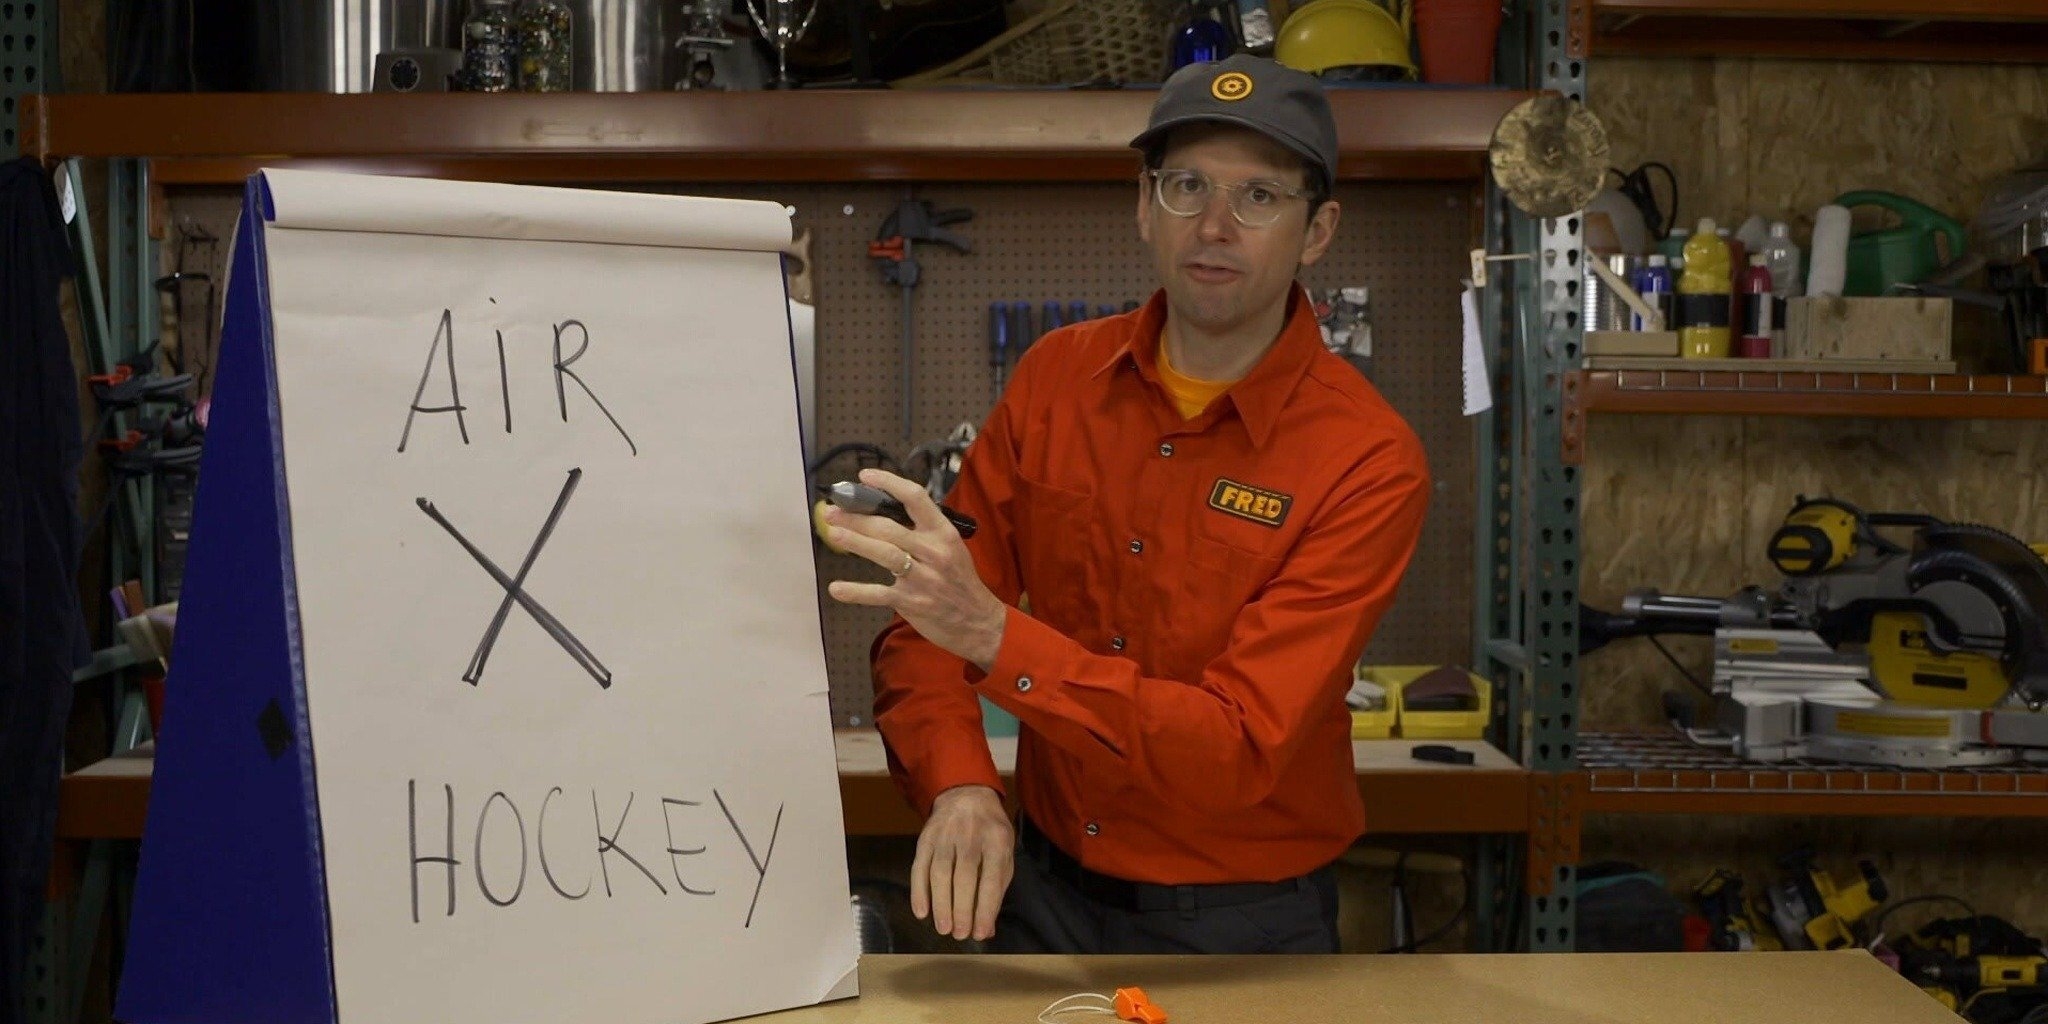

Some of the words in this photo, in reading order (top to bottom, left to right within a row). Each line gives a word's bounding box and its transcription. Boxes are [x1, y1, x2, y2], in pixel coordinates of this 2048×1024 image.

[1219, 485, 1282, 518] FRED
[415, 466, 612, 688] X
[408, 778, 785, 928] HOCKEY
